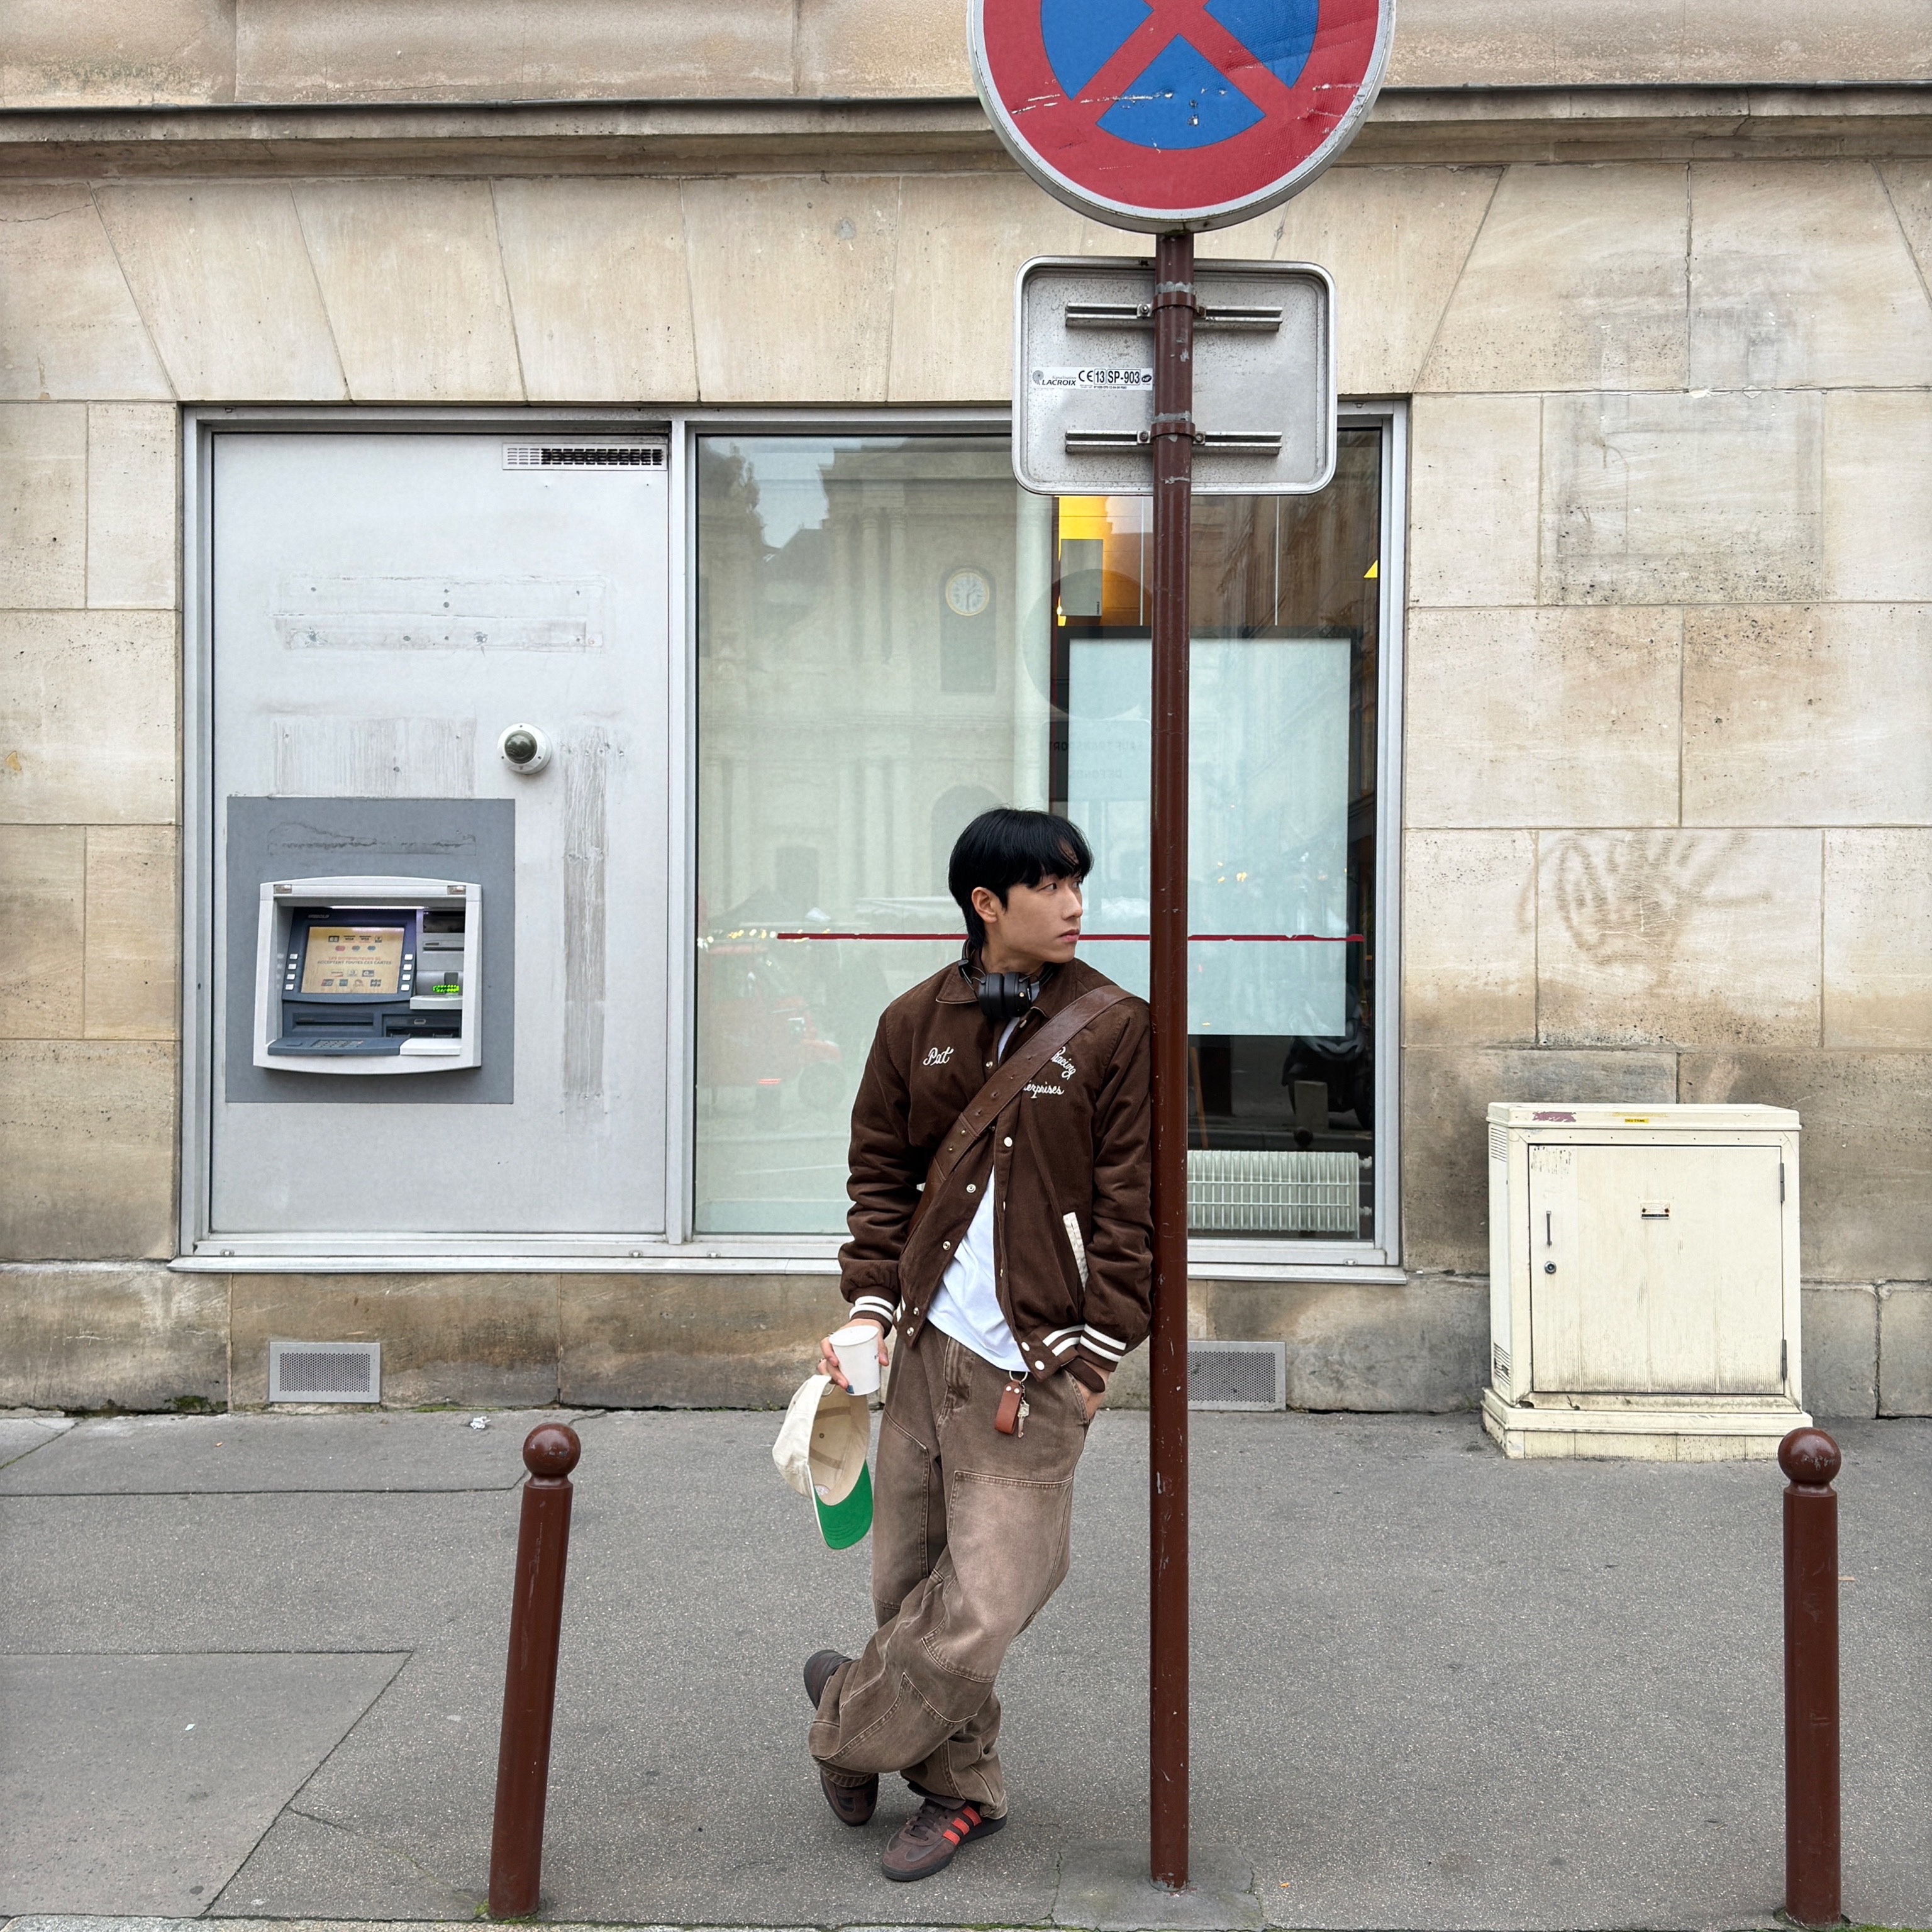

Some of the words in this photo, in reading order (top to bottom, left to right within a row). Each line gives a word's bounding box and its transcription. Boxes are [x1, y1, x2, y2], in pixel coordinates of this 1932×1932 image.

[1079, 370, 1093, 382] CE
[1096, 370, 1105, 384] 13
[1108, 370, 1140, 384] SP-903
[923, 1046, 954, 1067] Pat
